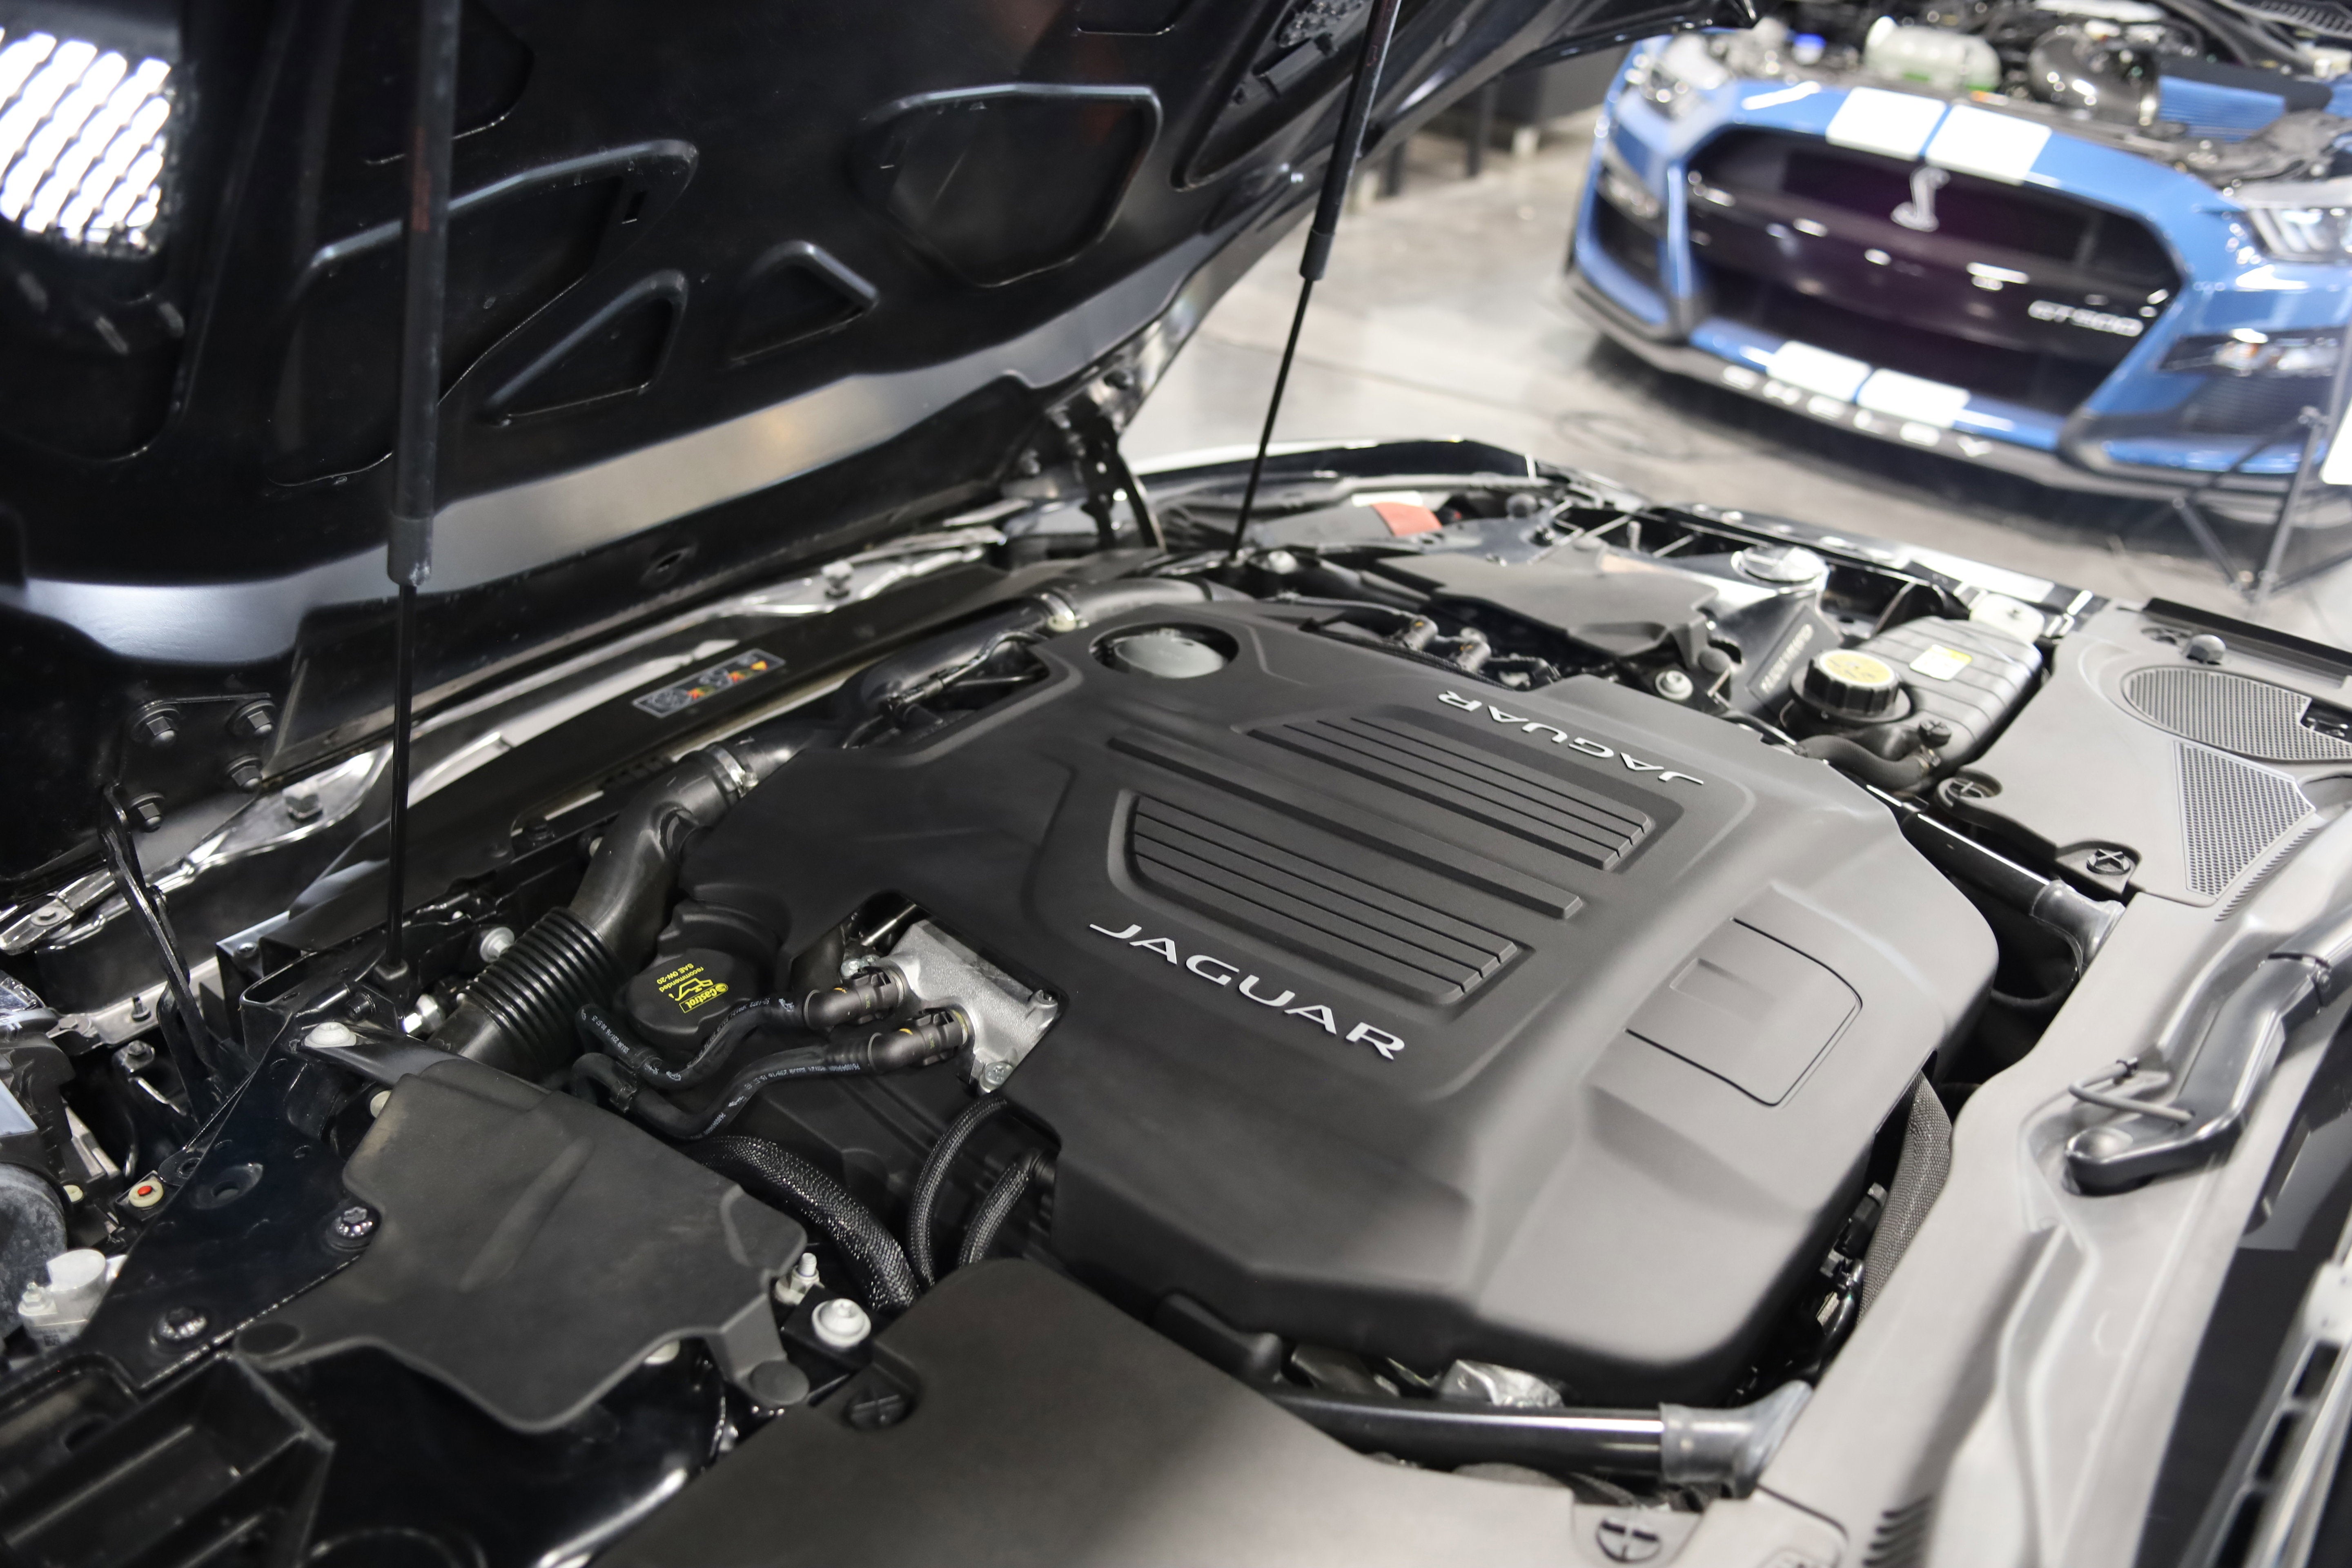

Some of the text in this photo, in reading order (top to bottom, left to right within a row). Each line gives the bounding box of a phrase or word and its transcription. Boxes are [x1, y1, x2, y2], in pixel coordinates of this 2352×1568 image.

[1437, 690, 1704, 785] JAGUAR
[657, 963, 694, 984] SAE 0W-20
[659, 966, 704, 993] recommended
[685, 988, 717, 1009] Castrol
[1089, 923, 1405, 1060] JAGUAR
